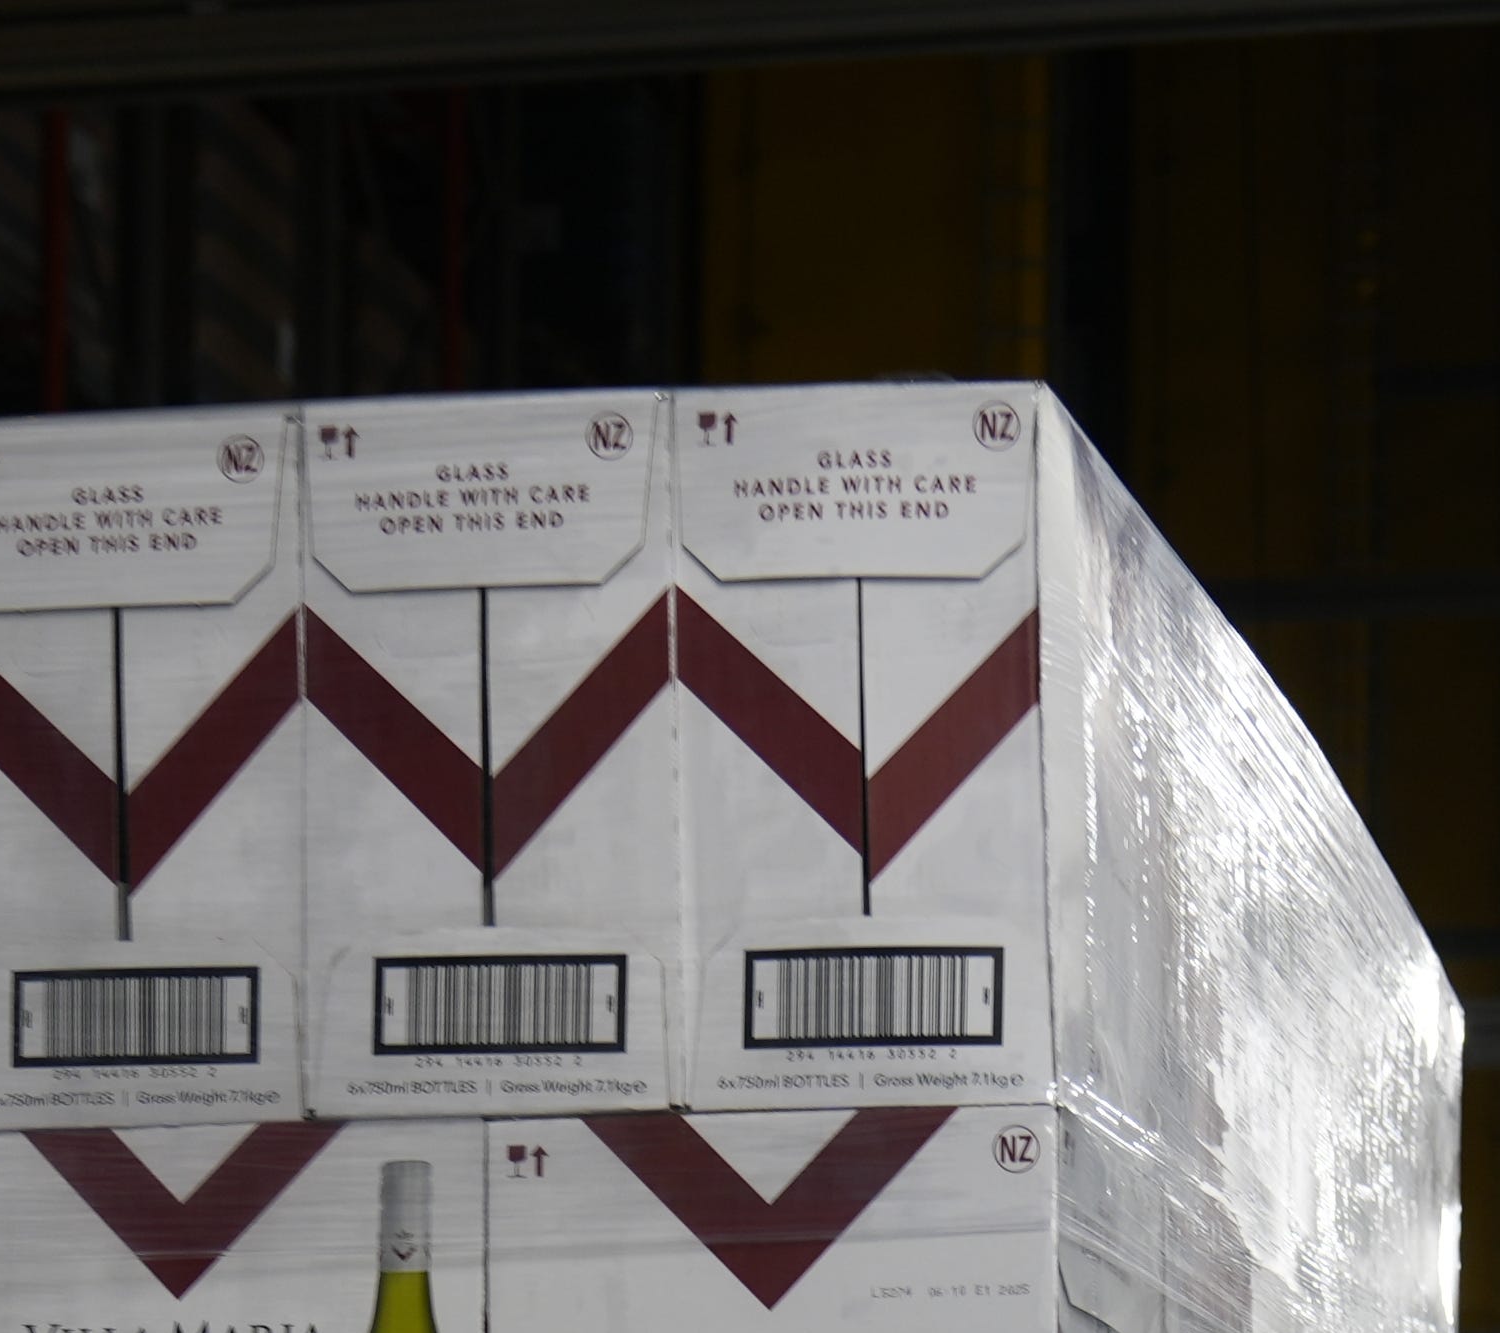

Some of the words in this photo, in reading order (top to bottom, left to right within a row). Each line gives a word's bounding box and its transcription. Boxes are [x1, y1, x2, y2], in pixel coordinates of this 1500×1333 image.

[979, 408, 1016, 443] NZ
[818, 451, 891, 469] GLASS
[734, 478, 828, 497] HANDLE
[842, 476, 901, 493] WITH
[915, 476, 975, 492] CARE
[759, 503, 822, 521] OPEN
[836, 501, 887, 519] THIS
[901, 502, 948, 518] END
[998, 1132, 1036, 1167] NZ
